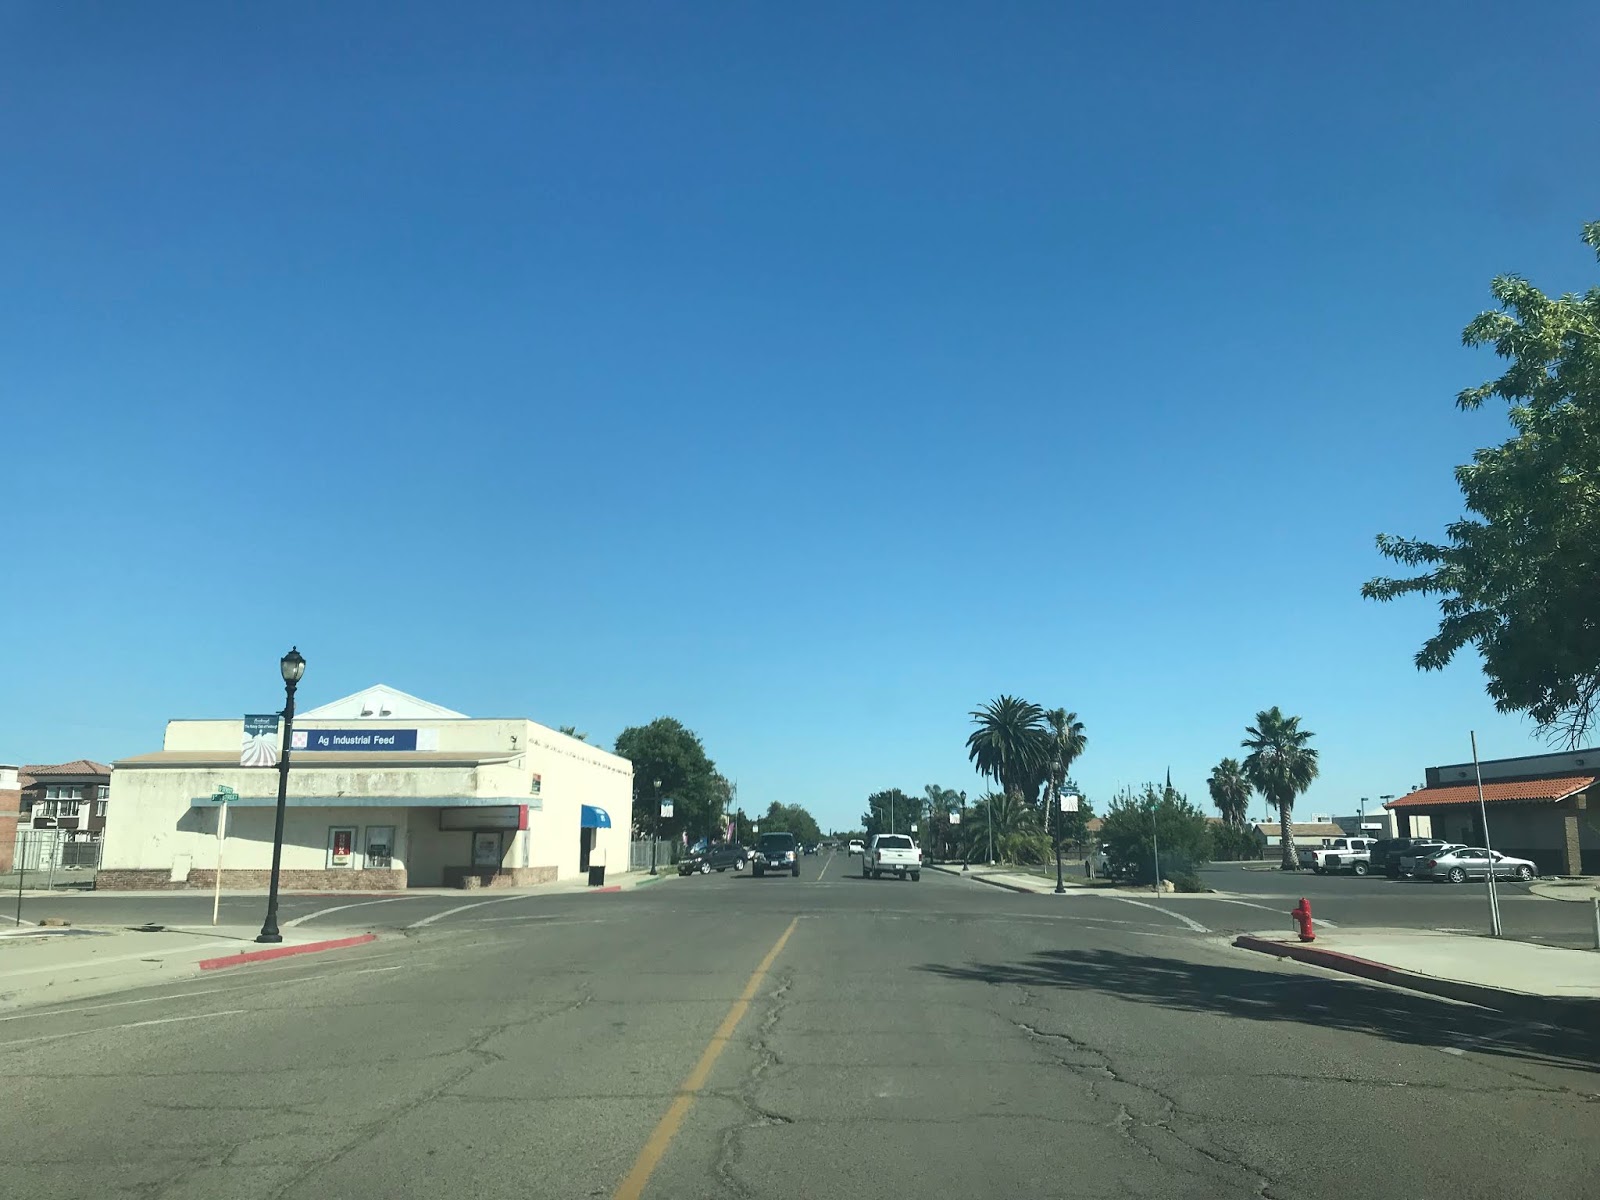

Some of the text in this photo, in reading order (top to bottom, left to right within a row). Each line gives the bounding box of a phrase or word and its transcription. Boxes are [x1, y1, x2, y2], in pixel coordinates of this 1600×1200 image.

[318, 735, 395, 746] Ag Industrial Feed
